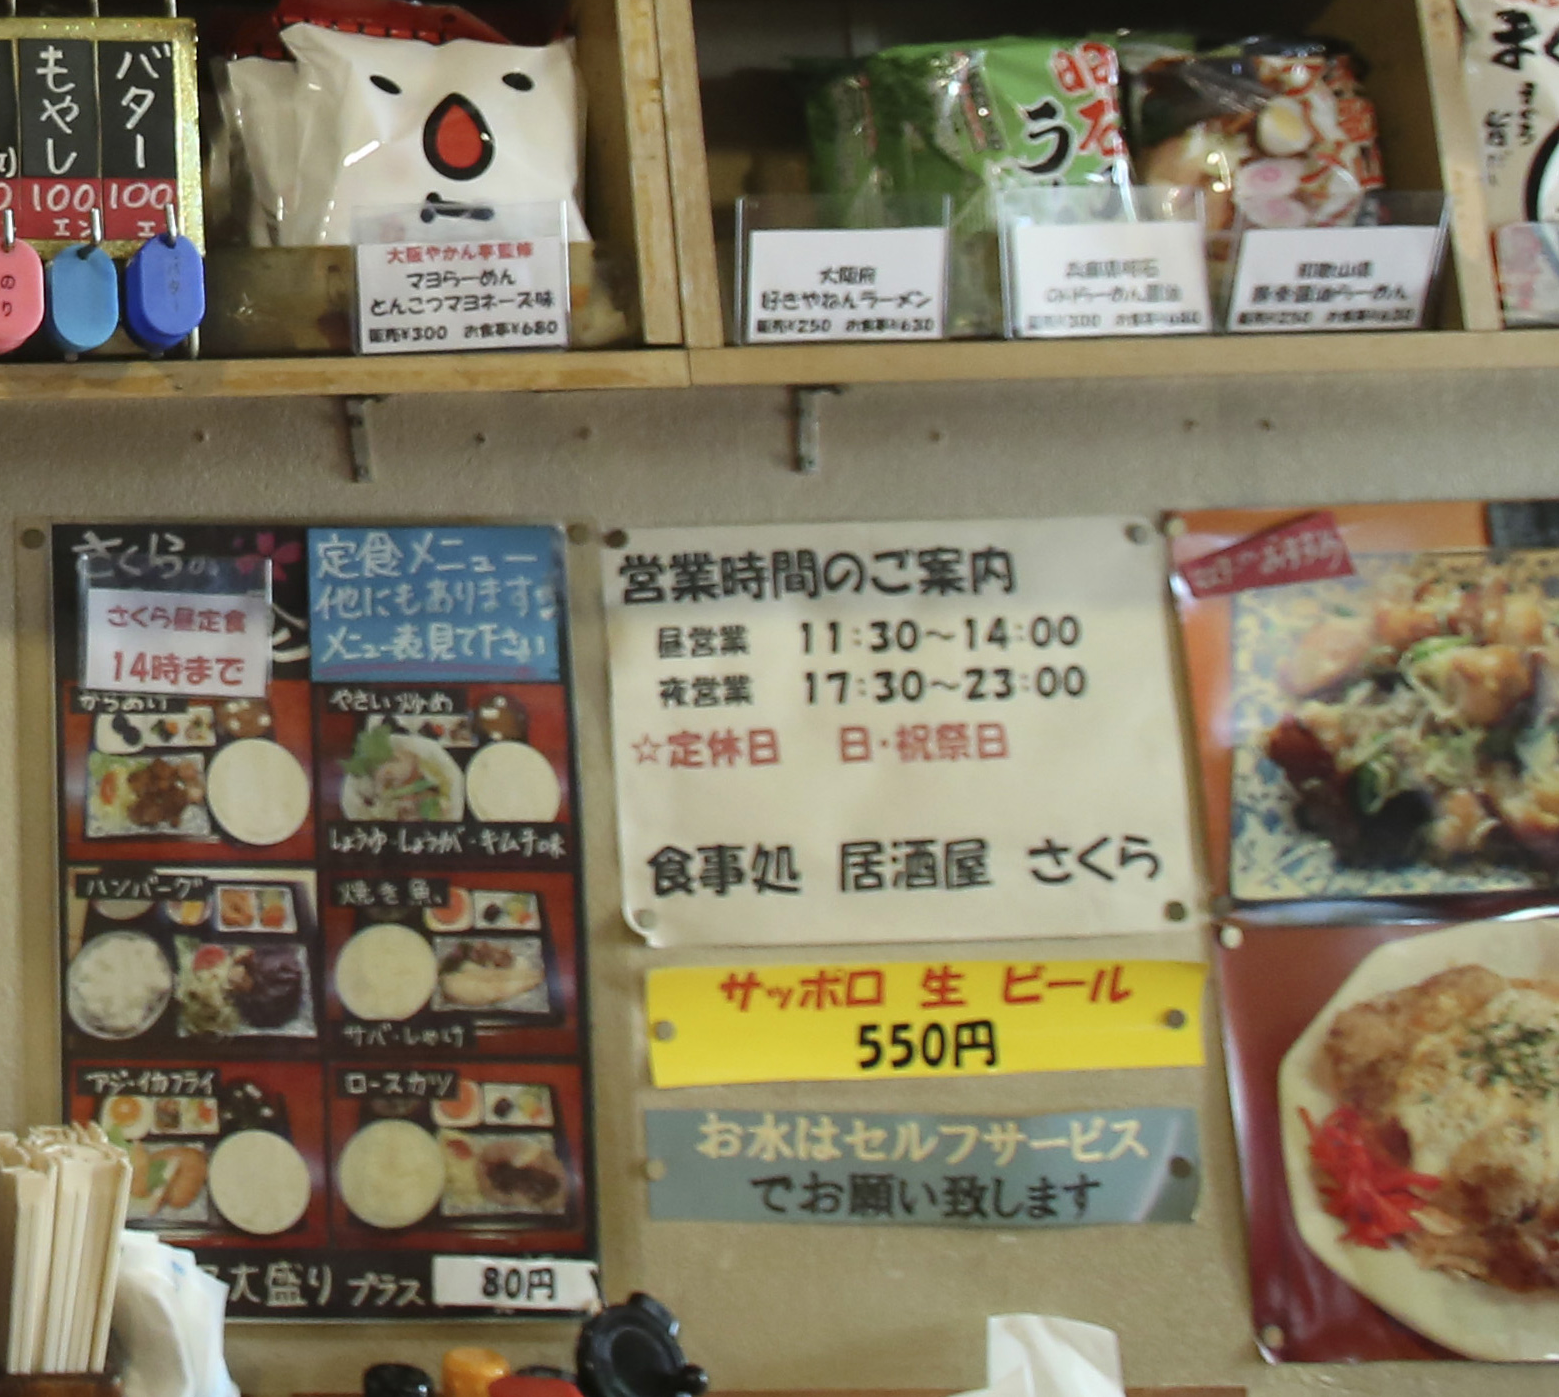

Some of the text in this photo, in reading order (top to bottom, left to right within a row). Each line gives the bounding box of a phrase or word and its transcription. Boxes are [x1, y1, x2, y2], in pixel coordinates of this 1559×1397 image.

[36, 44, 81, 175] もやし
[116, 41, 174, 171] バター
[32, 183, 96, 211] 100
[109, 181, 174, 210] 100
[0, 274, 17, 317] のり
[406, 270, 516, 289] マヨらーめん
[819, 266, 877, 285] 大阪府
[369, 291, 554, 318] とんこつマヨネーズ味
[316, 533, 538, 580] 定食メニュー
[618, 545, 1018, 608] 営業時間のご案内
[657, 623, 751, 660] 昼営業
[112, 652, 245, 684] 14時まで
[659, 672, 754, 708] 夜営業
[647, 831, 1165, 899] 食事処 居酒屋 さくら
[719, 964, 1133, 1011] サッポロ 生 ビール
[856, 1018, 999, 1071] 550円
[696, 1113, 1150, 1164] お水はセルフサービス
[750, 1173, 1102, 1222] でお願い致します
[482, 1267, 556, 1300] 80円
